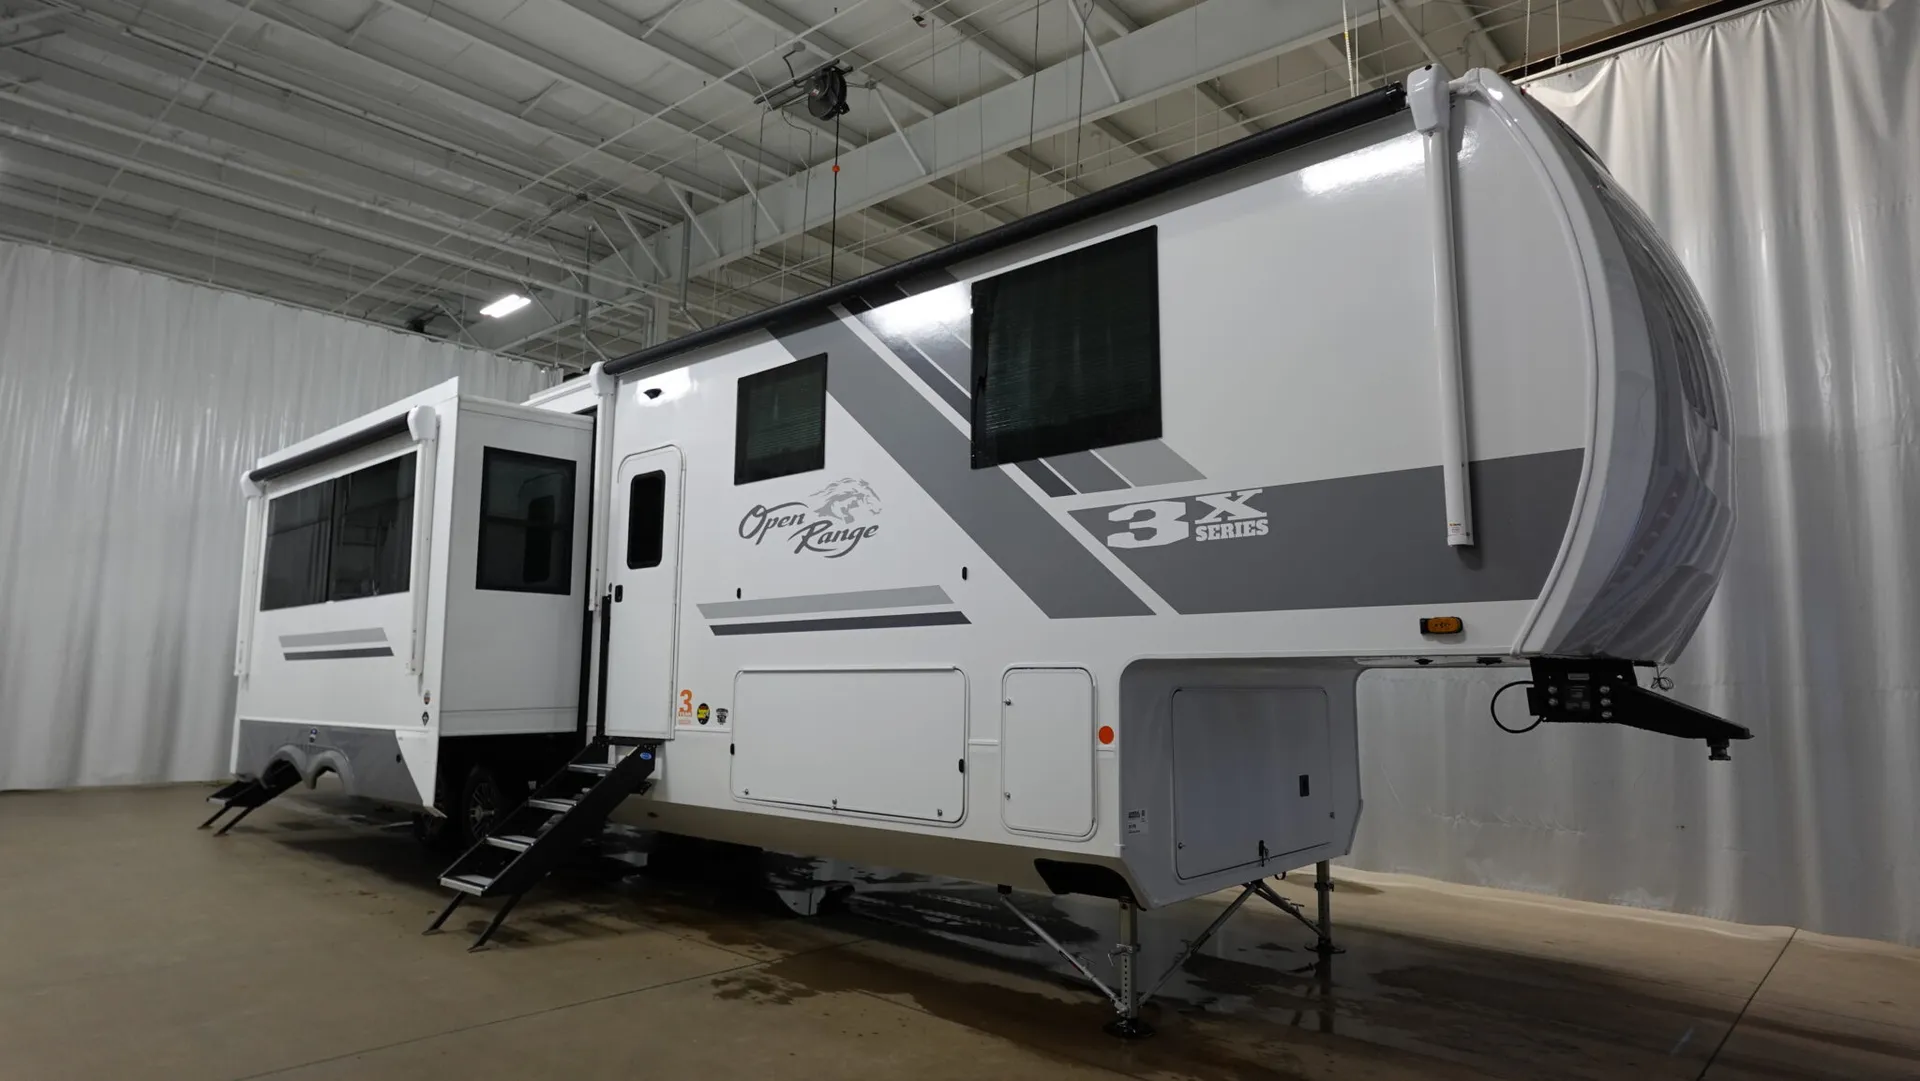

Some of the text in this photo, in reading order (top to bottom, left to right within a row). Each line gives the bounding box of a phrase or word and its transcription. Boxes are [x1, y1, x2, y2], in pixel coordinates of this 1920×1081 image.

[738, 501, 809, 545] Open
[1107, 488, 1268, 549] 3 X
[1195, 519, 1269, 542] SERIES
[787, 519, 879, 558] Range
[679, 689, 693, 712] 3
